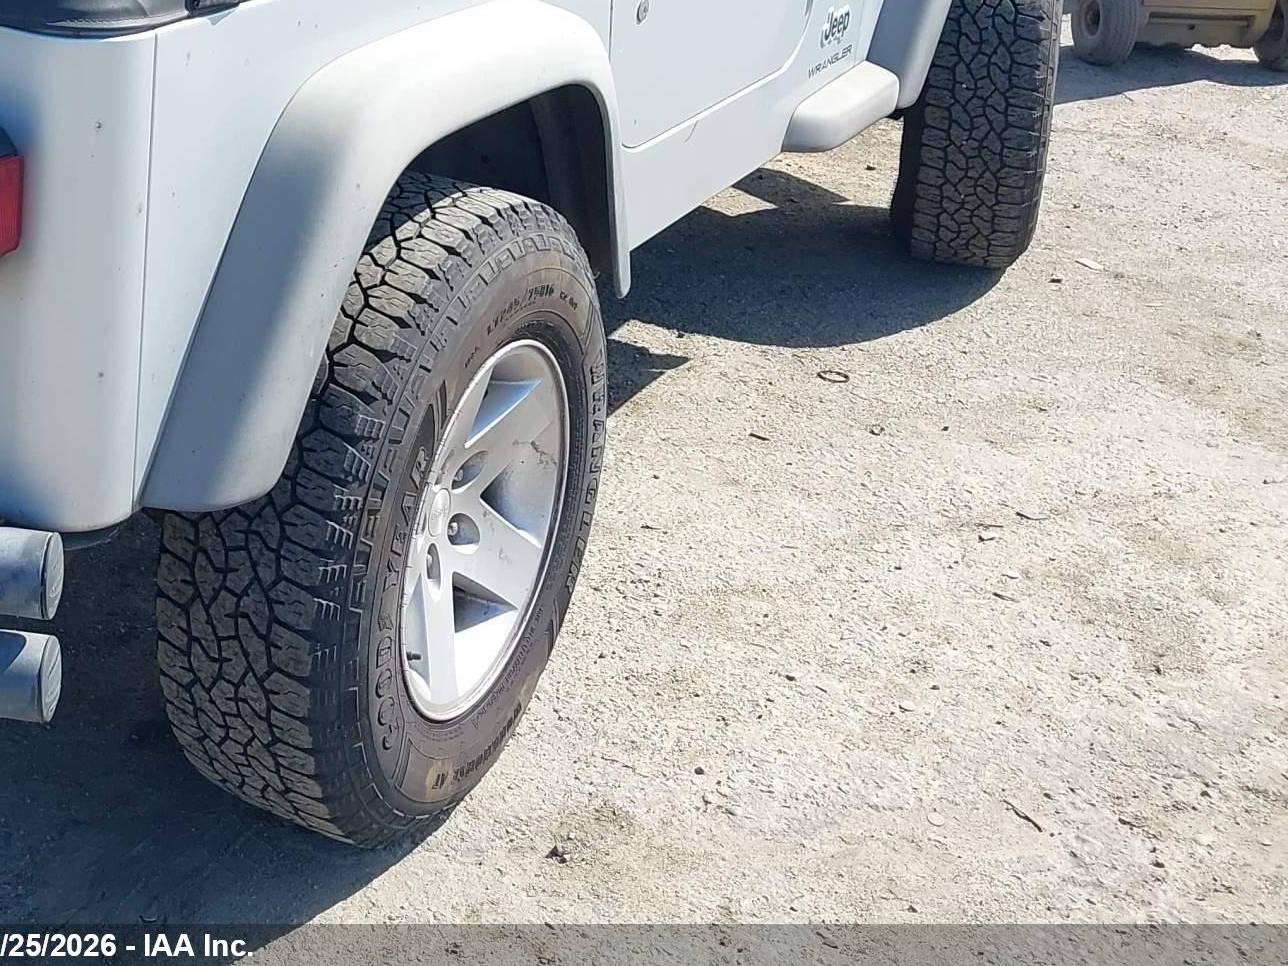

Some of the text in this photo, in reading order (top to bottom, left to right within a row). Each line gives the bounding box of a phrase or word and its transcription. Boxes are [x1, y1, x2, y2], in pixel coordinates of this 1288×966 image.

[808, 44, 853, 80] WRANGLER
[823, 7, 851, 43] Jeep
[565, 347, 607, 596] WRANGLER
[375, 446, 430, 751] GOODYEAR
